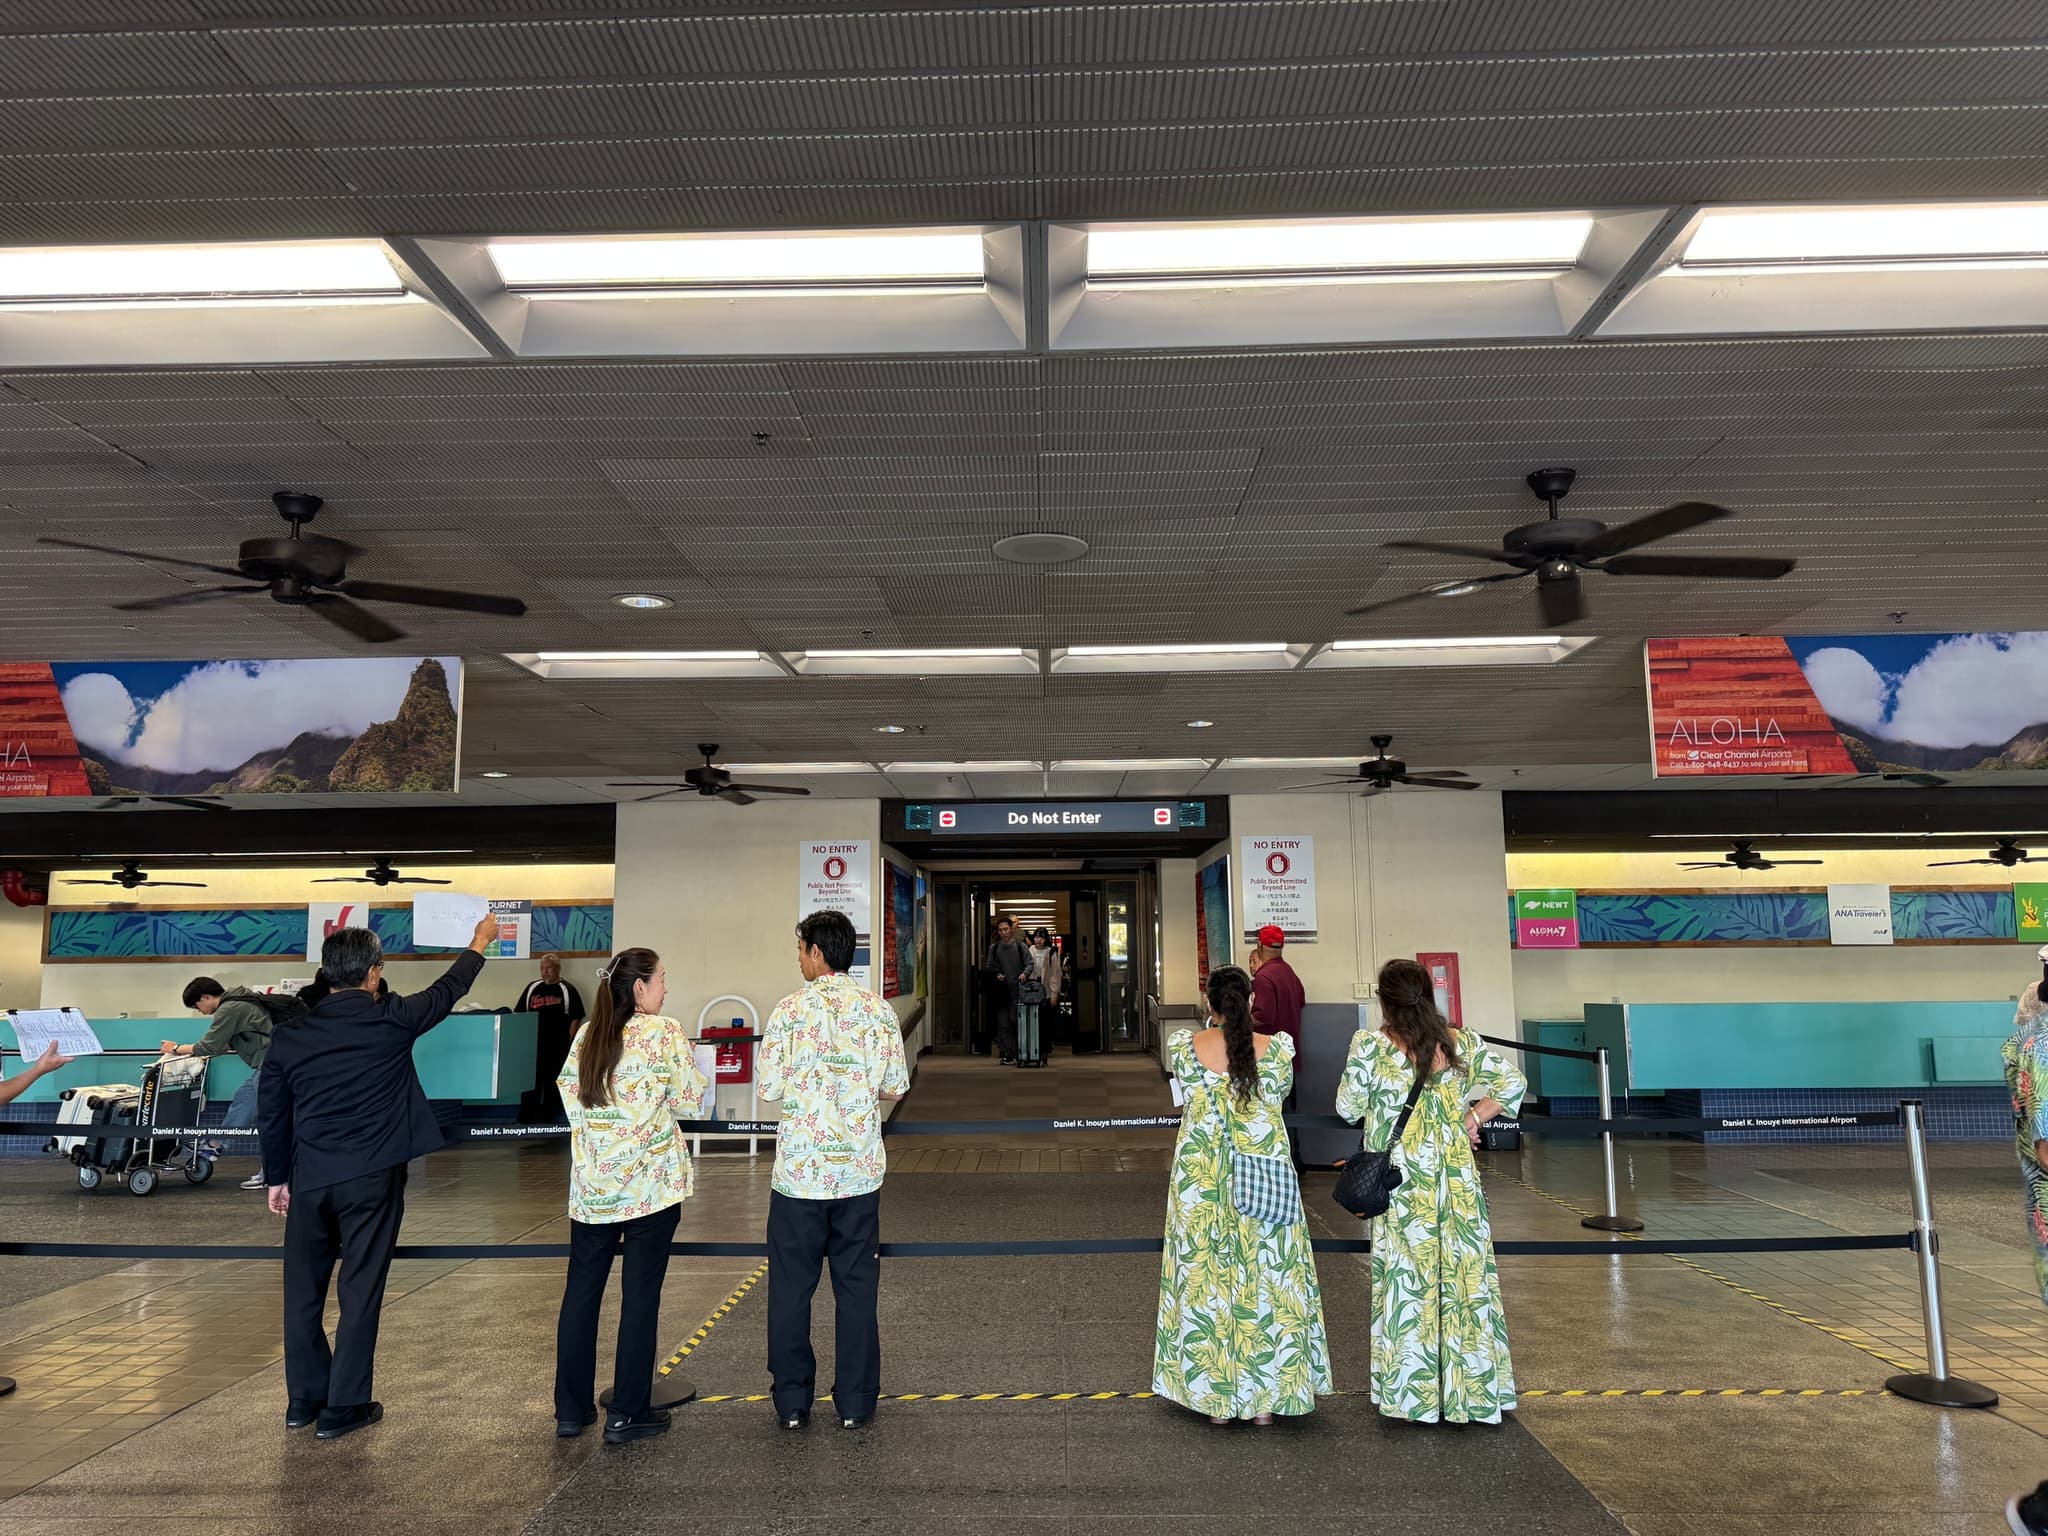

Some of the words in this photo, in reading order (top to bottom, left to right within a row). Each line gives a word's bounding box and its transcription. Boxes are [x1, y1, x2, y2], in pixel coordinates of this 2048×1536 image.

[1669, 718, 1786, 745] ALOHA
[1700, 751, 1723, 759] Clear
[1724, 750, 1760, 759] Channel
[1760, 750, 1792, 759] Airports
[1764, 761, 1780, 769] your
[1008, 812, 1029, 825] Do
[1032, 811, 1059, 825] Not
[1062, 811, 1101, 824] Enter
[812, 846, 827, 854] NO
[829, 845, 858, 853] ENTRY
[1254, 841, 1268, 849] NO
[1272, 841, 1300, 849] ENTRY
[1262, 884, 1283, 892] Beyond
[487, 901, 522, 909] OURNET
[1542, 901, 1568, 909] NEWT
[1054, 1120, 1076, 1128] Daniel
[1086, 1119, 1109, 1128] Inouye
[1111, 1117, 1157, 1126] International
[1493, 1121, 1520, 1130] Airport
[1756, 1118, 1780, 1127] Inouye
[1782, 1116, 1829, 1125] International
[1830, 1116, 1857, 1125] Airport
[184, 1128, 207, 1136] Inouye
[503, 1127, 526, 1136] Inouye
[527, 1125, 571, 1134] Internationa
